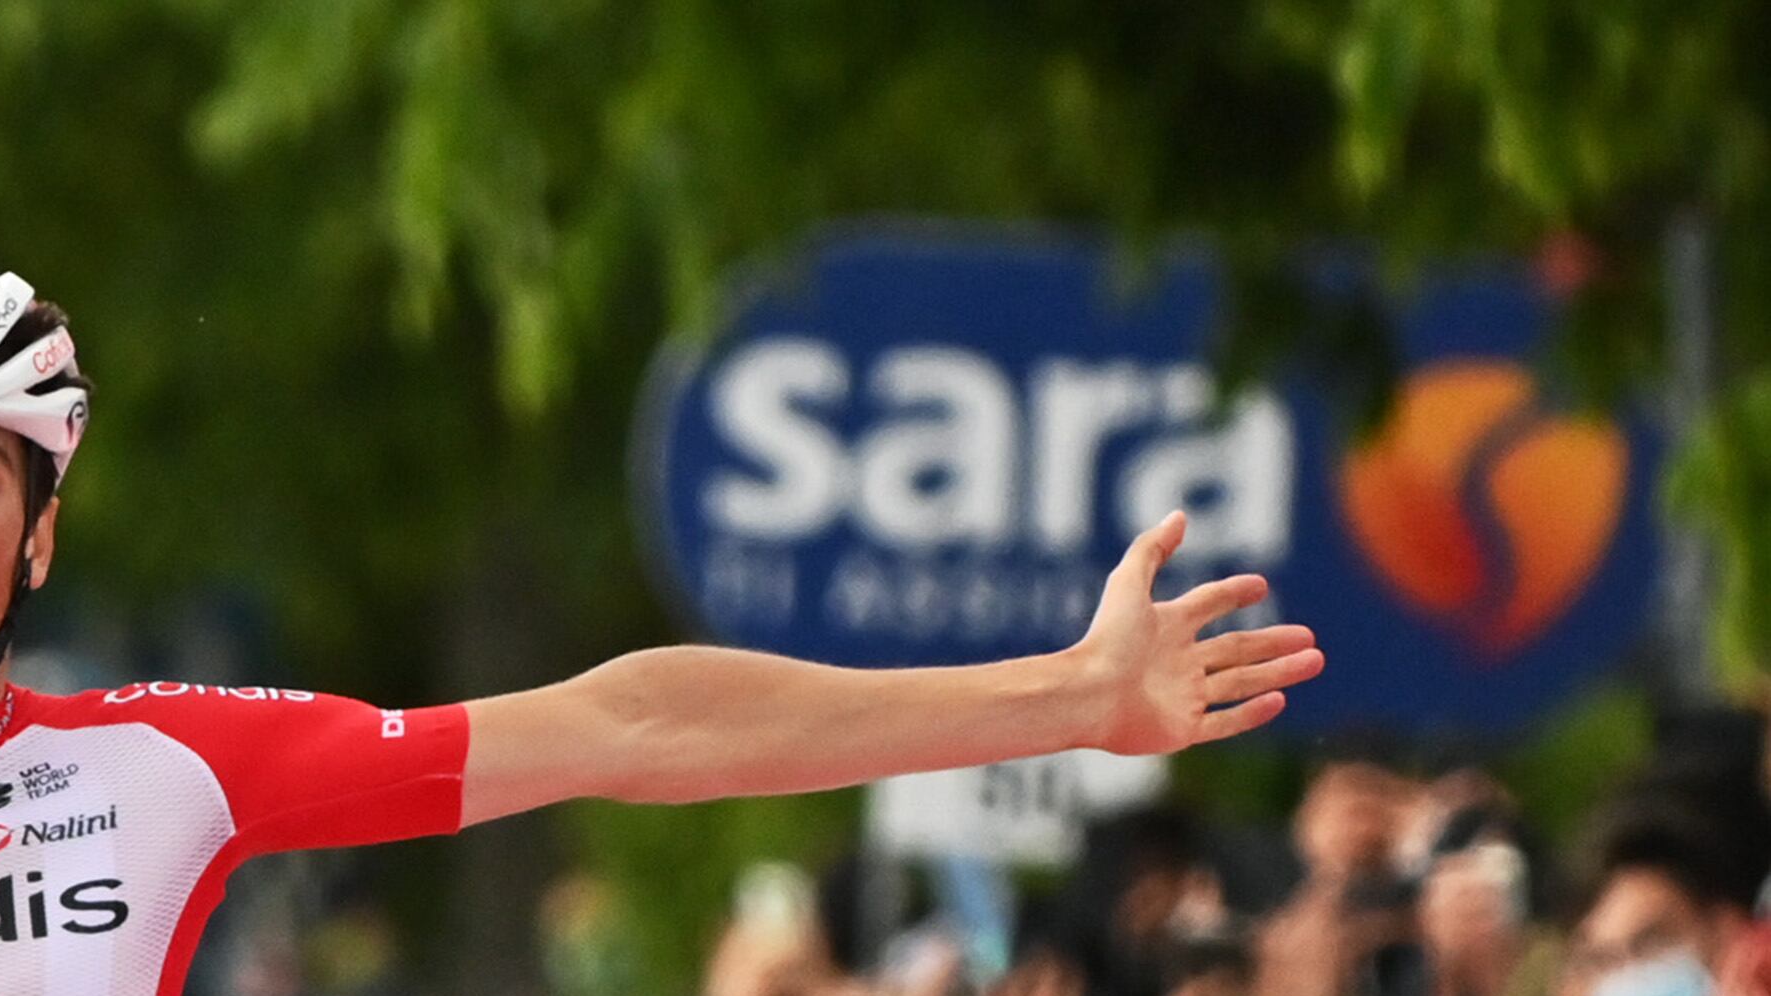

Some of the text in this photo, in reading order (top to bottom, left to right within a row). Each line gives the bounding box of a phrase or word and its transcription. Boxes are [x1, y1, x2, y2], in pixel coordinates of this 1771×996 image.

[700, 336, 1296, 563] sara
[19, 762, 51, 778] UCI
[22, 763, 80, 790] WORLD
[27, 779, 71, 800] TEAM
[21, 804, 118, 846] Nalini
